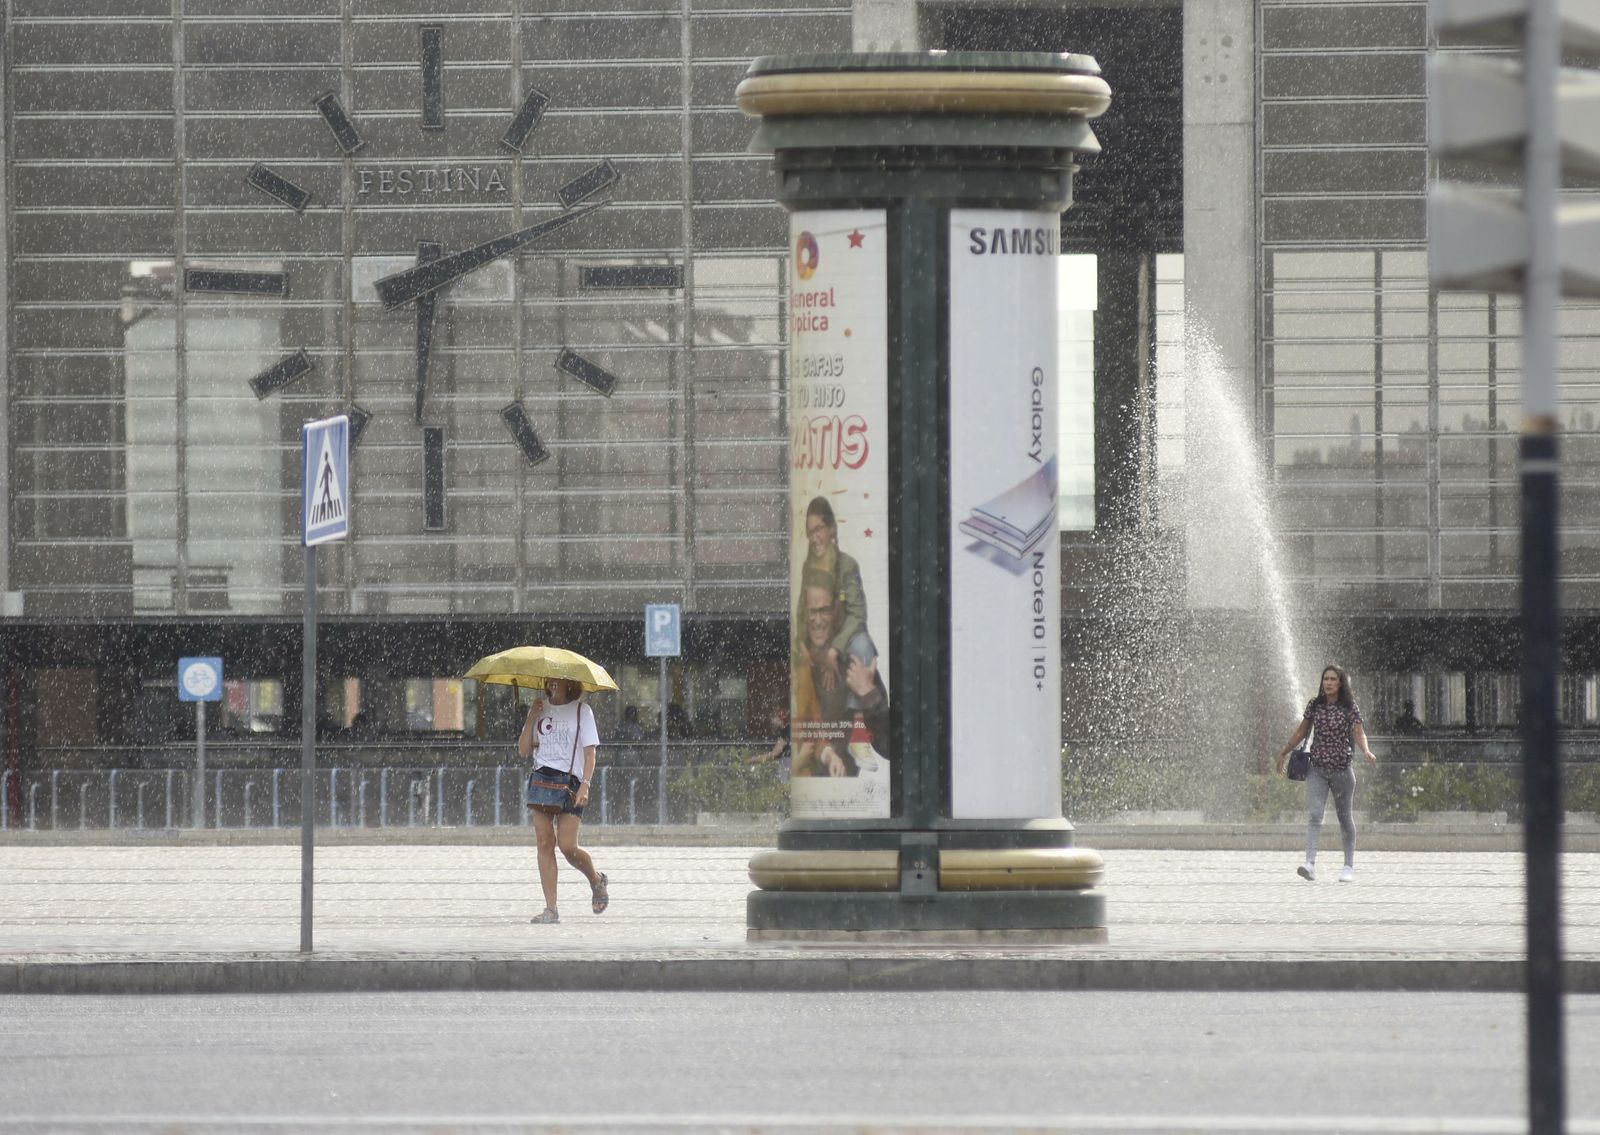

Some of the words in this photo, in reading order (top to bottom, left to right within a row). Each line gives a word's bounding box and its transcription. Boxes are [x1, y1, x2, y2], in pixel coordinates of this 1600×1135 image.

[358, 167, 506, 194] FESTINA
[970, 227, 1058, 255] SAMSU
[1028, 366, 1044, 464] Galaxy
[1032, 552, 1046, 640] Note10
[655, 611, 671, 633] P
[839, 721, 852, 729] 30%
